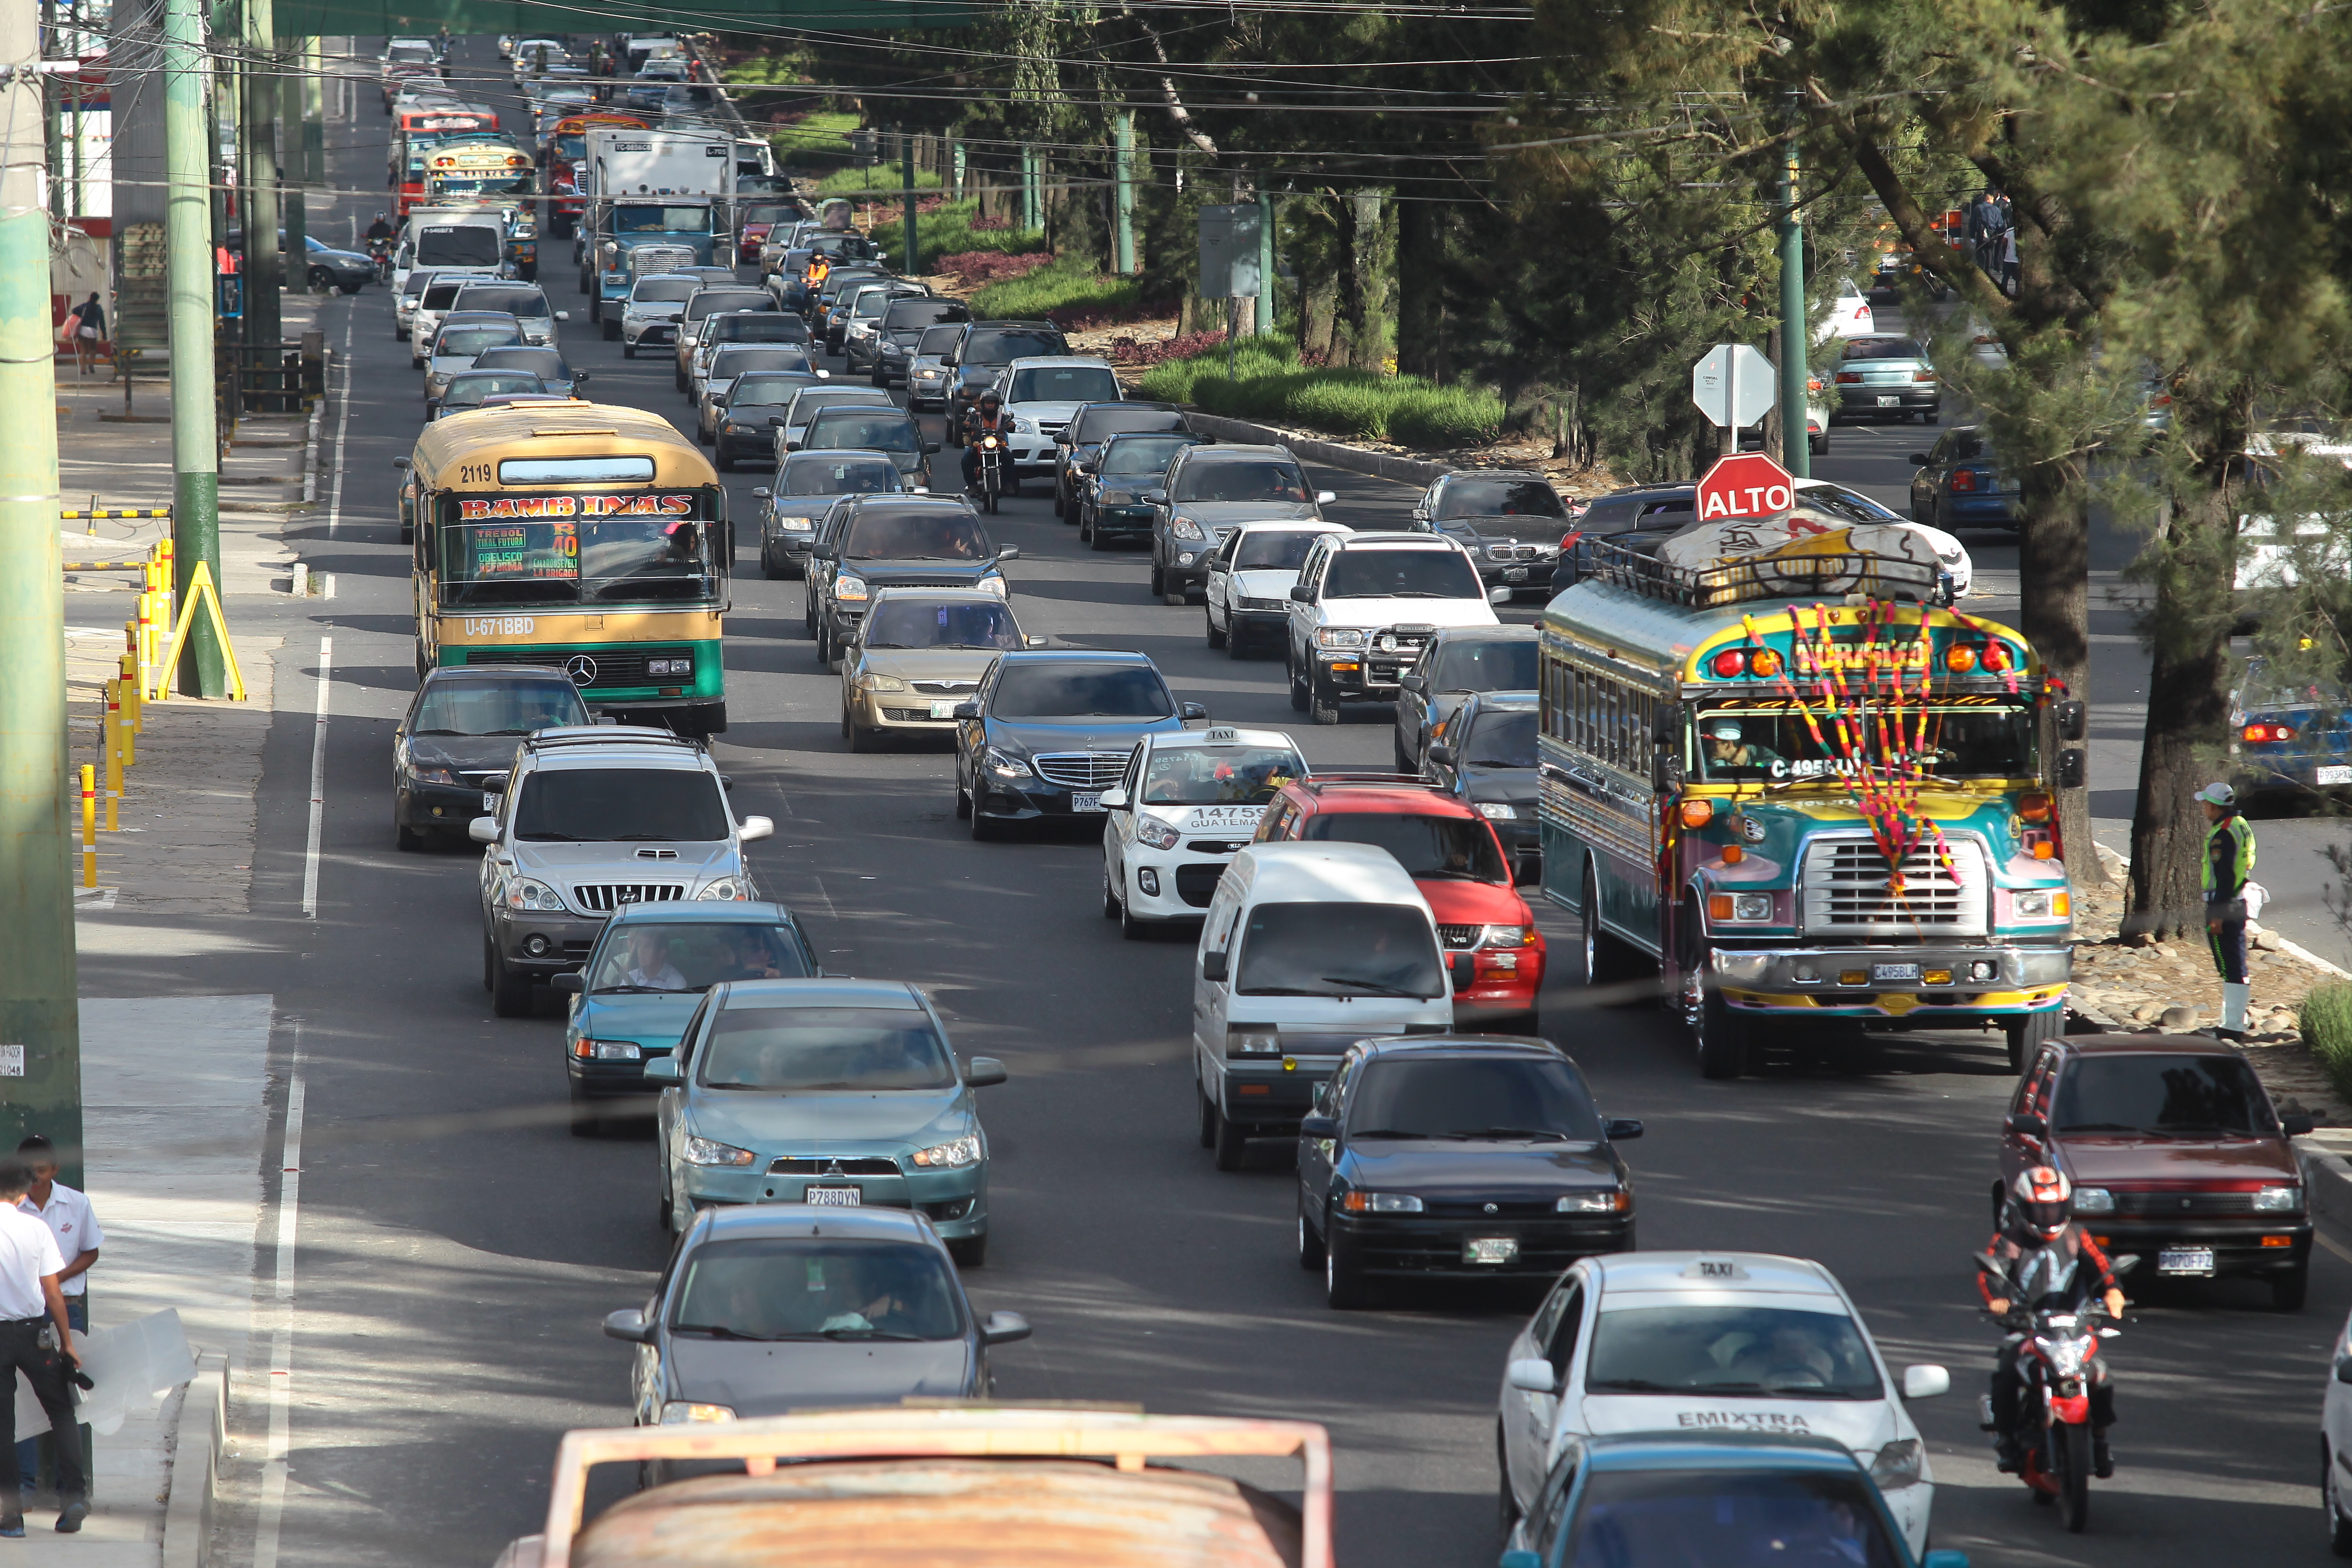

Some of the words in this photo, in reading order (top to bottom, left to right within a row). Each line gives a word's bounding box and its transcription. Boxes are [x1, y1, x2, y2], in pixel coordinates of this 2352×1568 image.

[461, 464, 491, 483] 2119
[1704, 485, 1790, 517] ALTO
[478, 529, 523, 538] TREBOL
[553, 523, 576, 535] R
[478, 539, 497, 547] TIKAL
[498, 537, 523, 547] FUTURA
[552, 536, 577, 557] 40
[478, 552, 523, 563] OBELISCO
[479, 562, 523, 572] REFORMA
[533, 569, 543, 577] LA
[545, 568, 578, 577] BRIGADA
[465, 617, 534, 636] U-671BBD
[1074, 797, 1100, 807] P767F
[1194, 808, 1267, 819] 14759
[1191, 819, 1262, 828] GUATEMA
[1875, 966, 1917, 978] C495BLH
[809, 1191, 858, 1205] P788DYN
[2160, 1255, 2213, 1267] P070FPZ
[1701, 1262, 1733, 1276] TAXI
[1678, 1412, 1810, 1427] EMIXTRA
